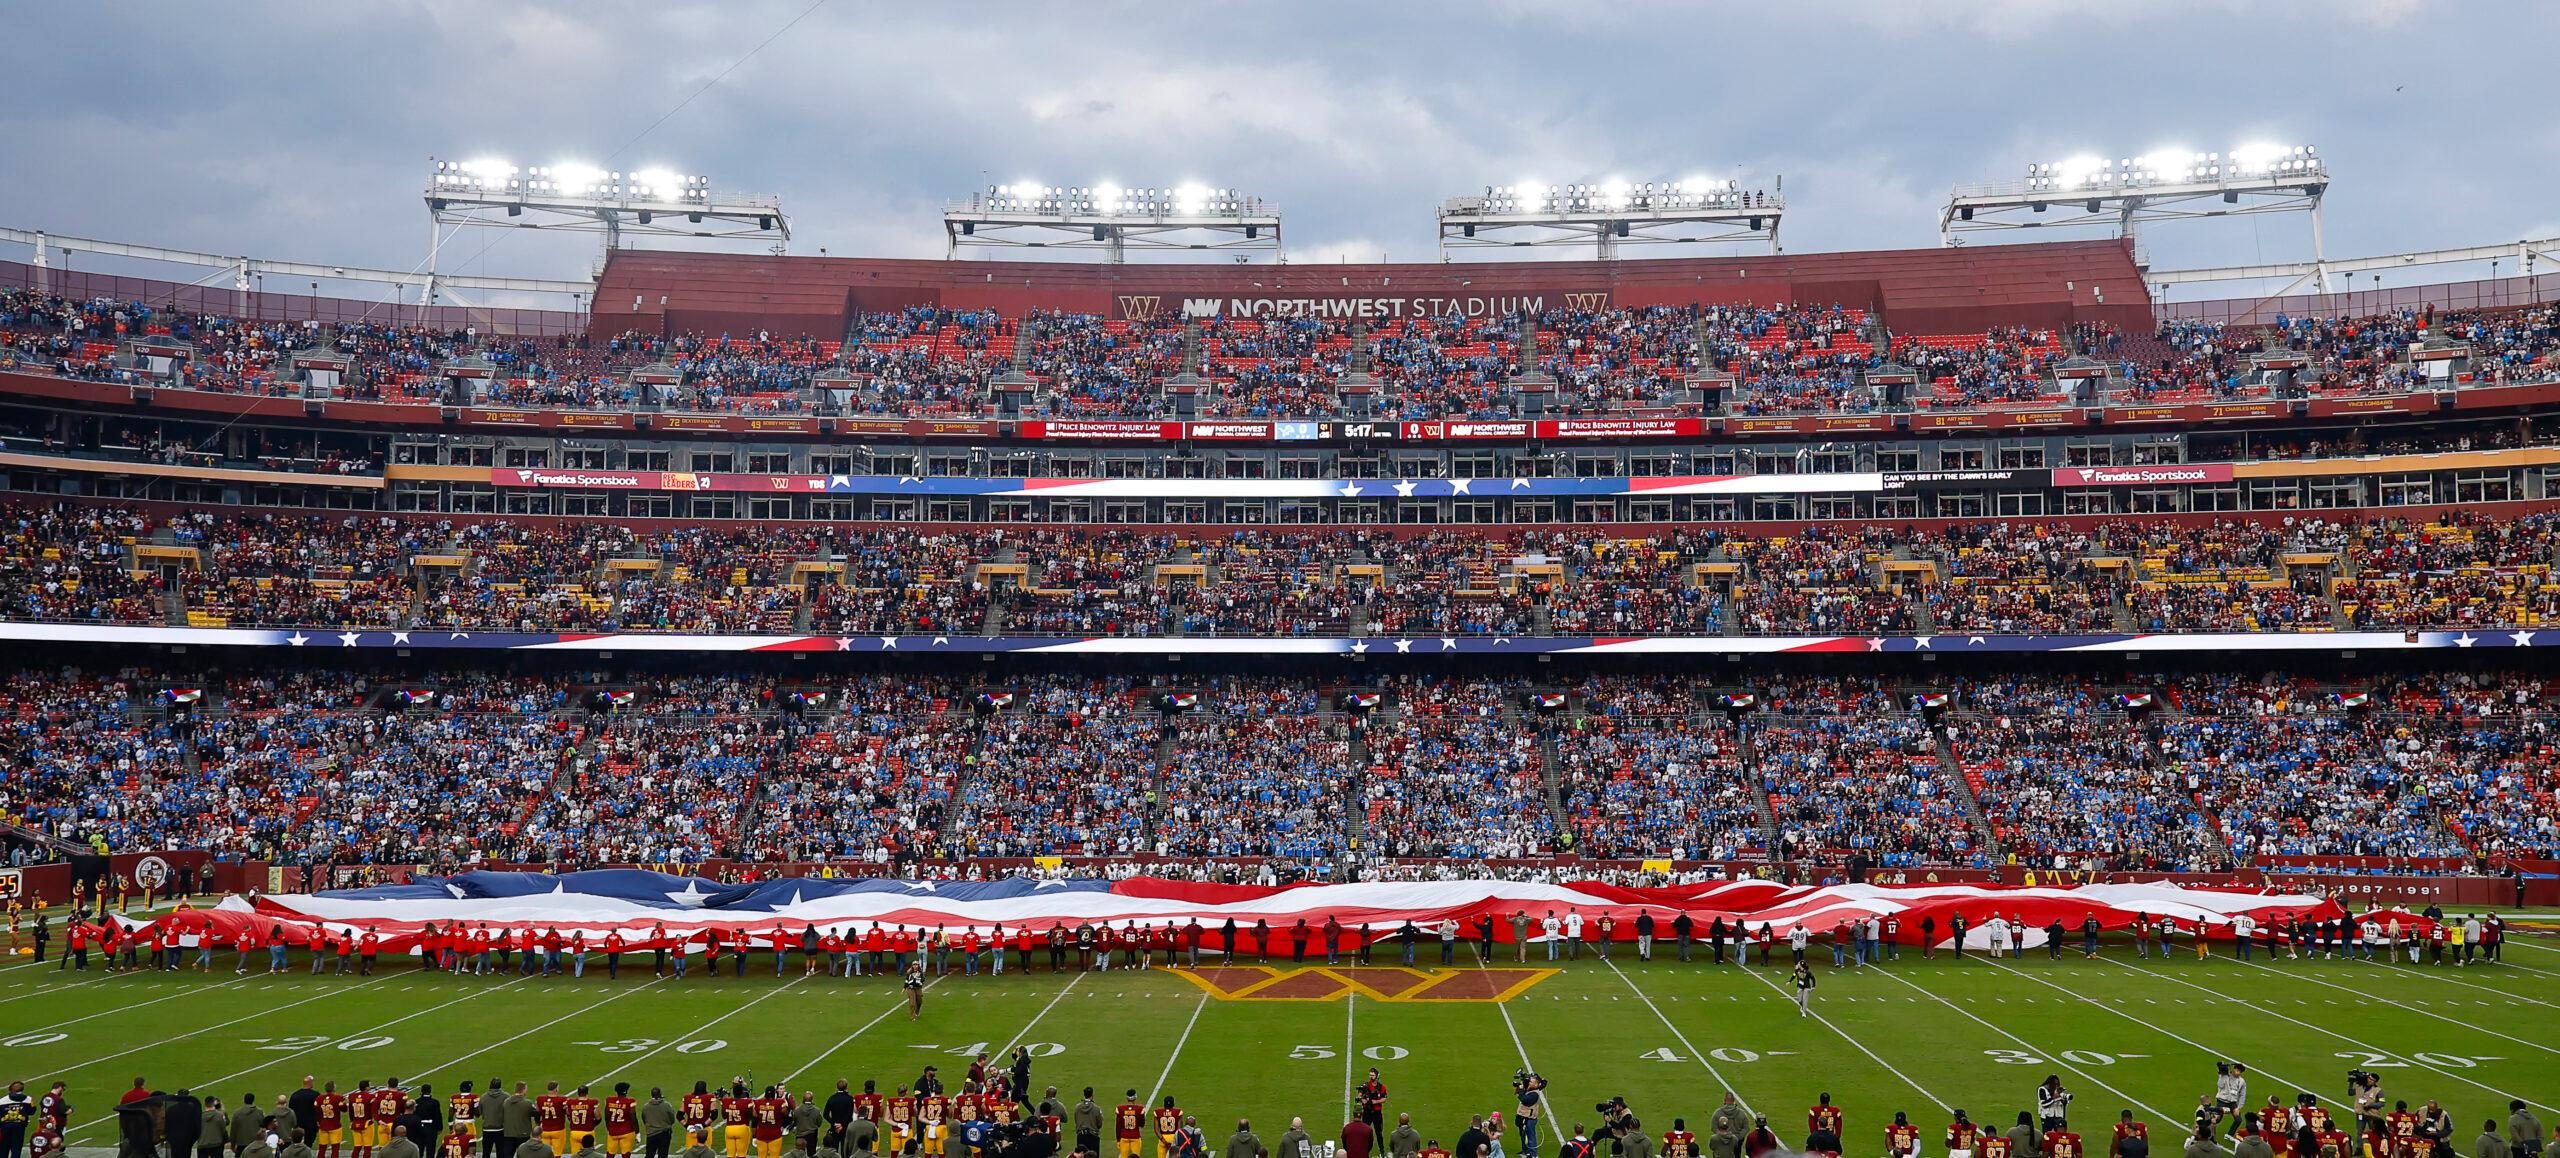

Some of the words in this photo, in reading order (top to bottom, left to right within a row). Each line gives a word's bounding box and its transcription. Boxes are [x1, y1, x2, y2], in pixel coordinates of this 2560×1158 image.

[1231, 298, 1405, 317] NORTHWEST
[1413, 296, 1542, 317] STADIUM
[486, 412, 498, 421] 70
[2127, 410, 2136, 420] 11
[2213, 407, 2223, 416] 71
[563, 415, 574, 424] 42
[669, 418, 680, 427] 72
[1825, 419, 1832, 428] 7
[1935, 417, 1945, 425] 81
[2015, 414, 2027, 423] 44
[751, 420, 761, 429] 49
[852, 423, 858, 431] 9
[933, 424, 944, 432] 33
[1058, 422, 1078, 431] PRICE
[1079, 423, 1117, 431] BENOWITZ
[1119, 423, 1144, 432] INJURY
[1215, 425, 1268, 433] NORTHWEST
[1300, 423, 1307, 434] 0
[1410, 423, 1420, 434] 0
[1570, 422, 1591, 430] PRICE
[1592, 421, 1630, 429] BENOWITZ
[1633, 421, 1658, 430] INJURY
[1743, 421, 1754, 430] 28
[1344, 424, 1372, 437] 5:17
[533, 473, 577, 485] Fanatics
[577, 474, 639, 488] Sportsbook
[1884, 474, 1900, 482] CAN
[1959, 472, 1988, 480] DAWN'S
[1988, 472, 2012, 480] EARLY
[2095, 471, 2140, 482] Fanatics
[2141, 469, 2206, 484] Sportsbook
[662, 479, 696, 488] LEADERS
[808, 479, 825, 489] YDS
[1887, 924, 1896, 933] 17
[1126, 933, 1136, 942] 89
[2433, 929, 2443, 940] 21
[256, 1035, 395, 1052] 20
[600, 1038, 729, 1054] 30
[1289, 1044, 1409, 1061] 50
[1638, 1047, 1760, 1063] 40
[1984, 1049, 2117, 1066] 30
[2335, 1051, 2477, 1068] 20
[352, 1103, 365, 1118] 10
[454, 1103, 471, 1118] 22
[609, 1108, 625, 1122] 72
[688, 1103, 703, 1119] 76
[927, 1104, 942, 1120] 82
[571, 1109, 587, 1125] 67
[759, 1110, 776, 1125] 74
[1160, 1116, 1176, 1132] 83
[2271, 1118, 2287, 1133] 52
[1671, 1144, 1688, 1158] 25
[2054, 1144, 2072, 1158] 94
[2379, 1138, 2389, 1156] 4
